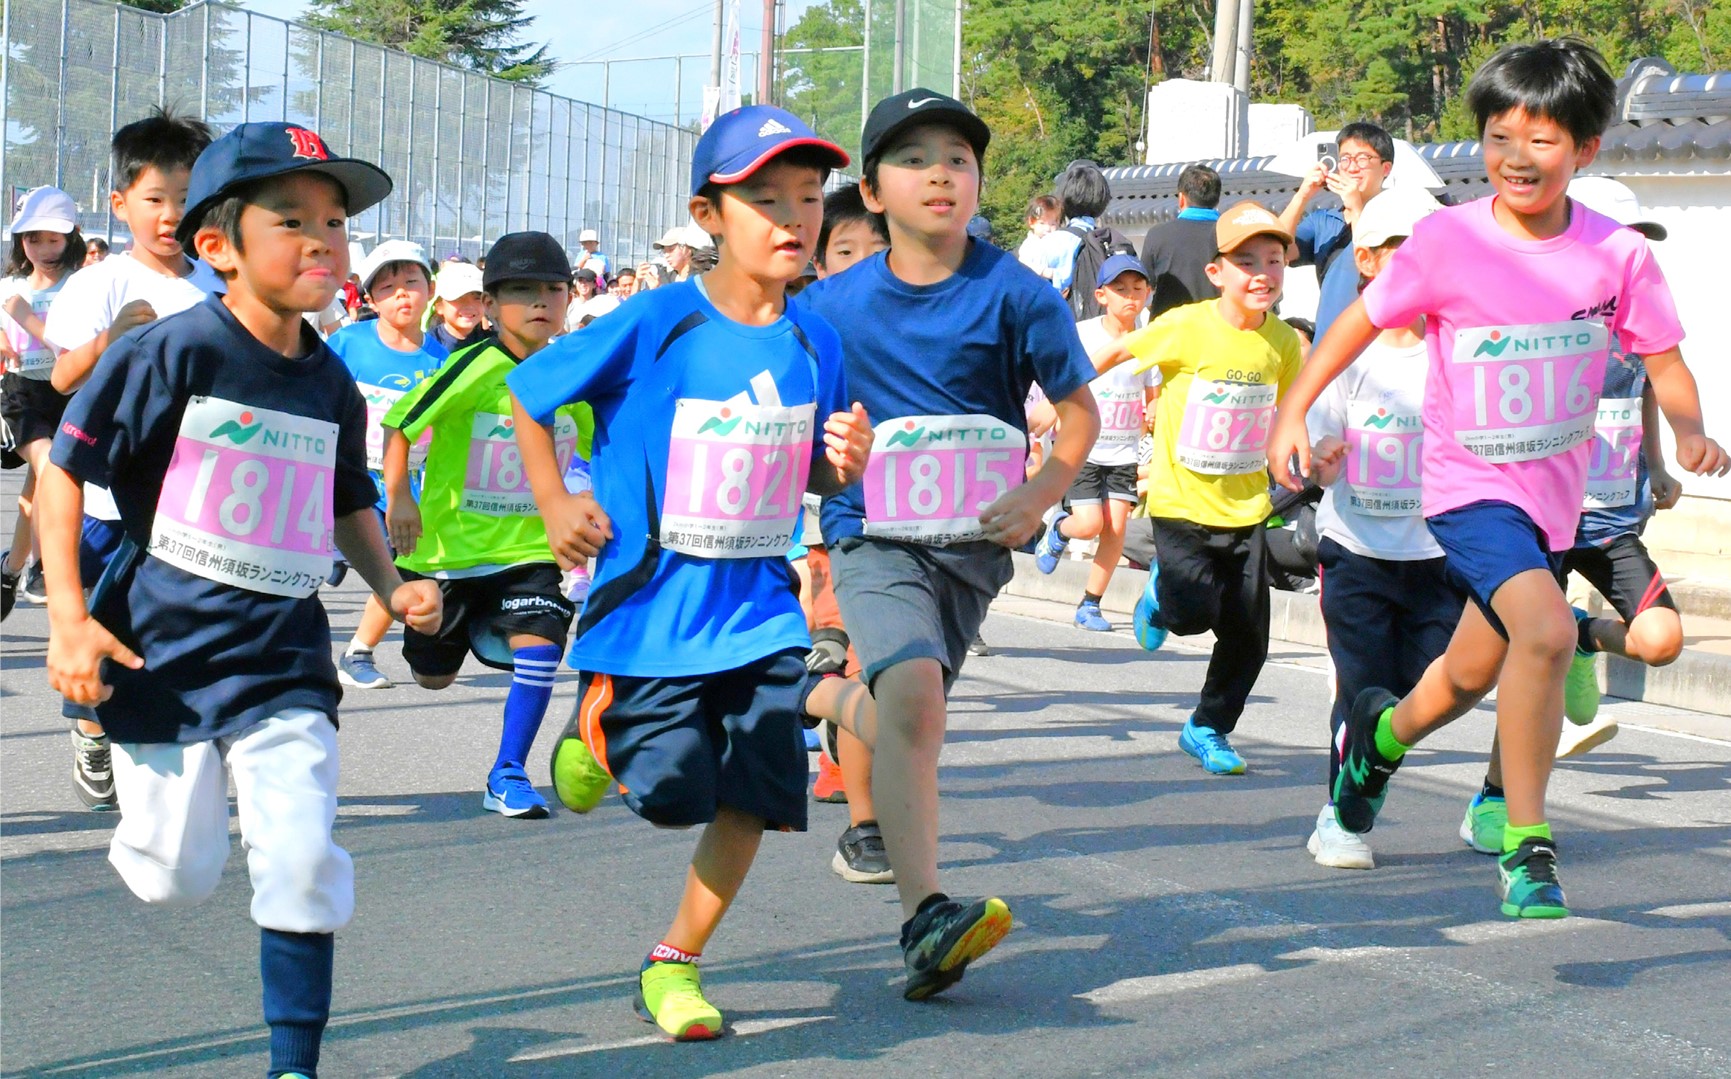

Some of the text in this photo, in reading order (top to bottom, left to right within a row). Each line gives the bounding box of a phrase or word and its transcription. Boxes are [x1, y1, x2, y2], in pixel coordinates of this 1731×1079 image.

[1515, 333, 1591, 351] NITTO
[1226, 369, 1261, 382] GO-GO
[1231, 393, 1274, 405] NITTO
[1474, 357, 1592, 426] 1816
[745, 420, 807, 436] NITTO
[1101, 402, 1140, 429] 806
[1598, 410, 1631, 420] TTO
[263, 429, 325, 455] NITTO
[929, 428, 1007, 442] NITTO
[1191, 408, 1272, 451] 1829
[689, 444, 802, 516] 1821
[885, 452, 1010, 517] 1815
[184, 449, 325, 550] 1814
